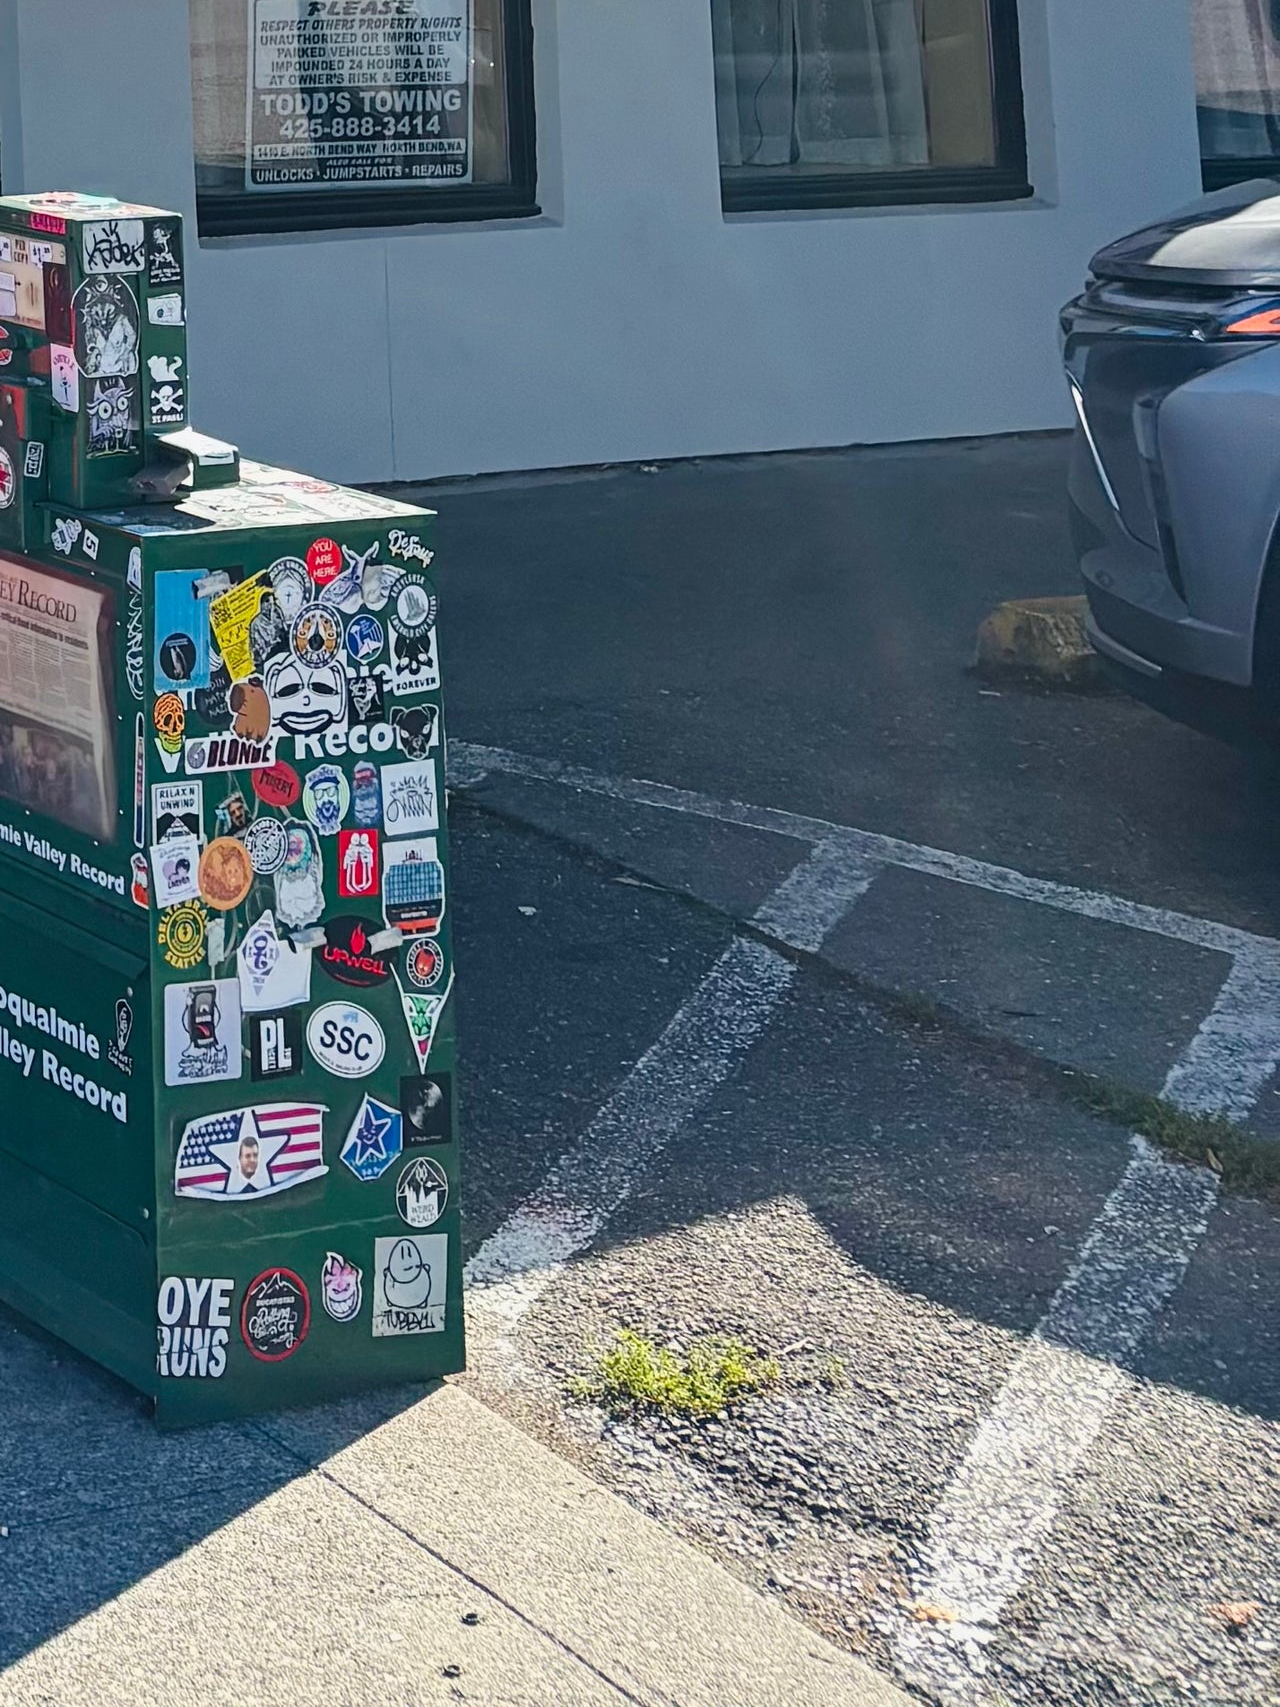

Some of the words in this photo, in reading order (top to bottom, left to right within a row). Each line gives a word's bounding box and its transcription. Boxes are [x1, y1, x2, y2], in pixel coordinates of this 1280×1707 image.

[307, 0, 416, 17] PLEASE
[260, 20, 310, 33] RESPECT
[311, 18, 355, 31] OTHERS
[358, 17, 417, 30] PROPERTY
[420, 16, 462, 29] RIGHTS
[260, 32, 357, 46] UNAUTHORIZED
[361, 32, 379, 43] OR
[383, 30, 462, 43] IMPROPERLY
[277, 46, 326, 59] PARKED
[330, 45, 391, 58] VEHICLES
[394, 44, 424, 56] WILL
[428, 43, 444, 55] BE
[271, 59, 345, 73] IMPOUNDED
[348, 59, 364, 70] 24
[366, 58, 410, 70] HOURS
[414, 57, 423, 69] A
[426, 57, 450, 69] DAY
[269, 74, 285, 86] AT
[288, 72, 345, 86] OWNER'S
[348, 72, 378, 84] RISK
[394, 71, 453, 83] EXPENSE
[260, 91, 351, 117] TODD'S
[359, 88, 462, 114] TOWING
[279, 115, 440, 138] 425-888-3414
[291, 144, 326, 156] NORTH
[327, 143, 354, 155] BEND
[356, 143, 377, 154] WAY
[382, 142, 416, 154] NORTH
[256, 168, 314, 182] UNLOCKS
[322, 165, 402, 179] JUMPSTARTS
[412, 163, 463, 177] REPAIRS
[312, 541, 332, 552] YOU
[315, 555, 333, 566] ARE
[313, 566, 337, 579] HERE
[17, 579, 77, 623] RECORD
[396, 677, 437, 692] FOREVER
[295, 717, 439, 759] Reco
[207, 736, 274, 768] BLONDE
[159, 788, 187, 800] RELAX
[160, 798, 195, 810] UNWIND
[24, 830, 67, 872] Valley
[70, 853, 125, 896] Record
[164, 947, 207, 969] SEATTLE
[323, 944, 388, 976] UPWELL
[319, 1019, 373, 1062] SSC
[42, 1048, 128, 1124] Record
[157, 1276, 235, 1327] OYE
[156, 1326, 229, 1378] RUNS
